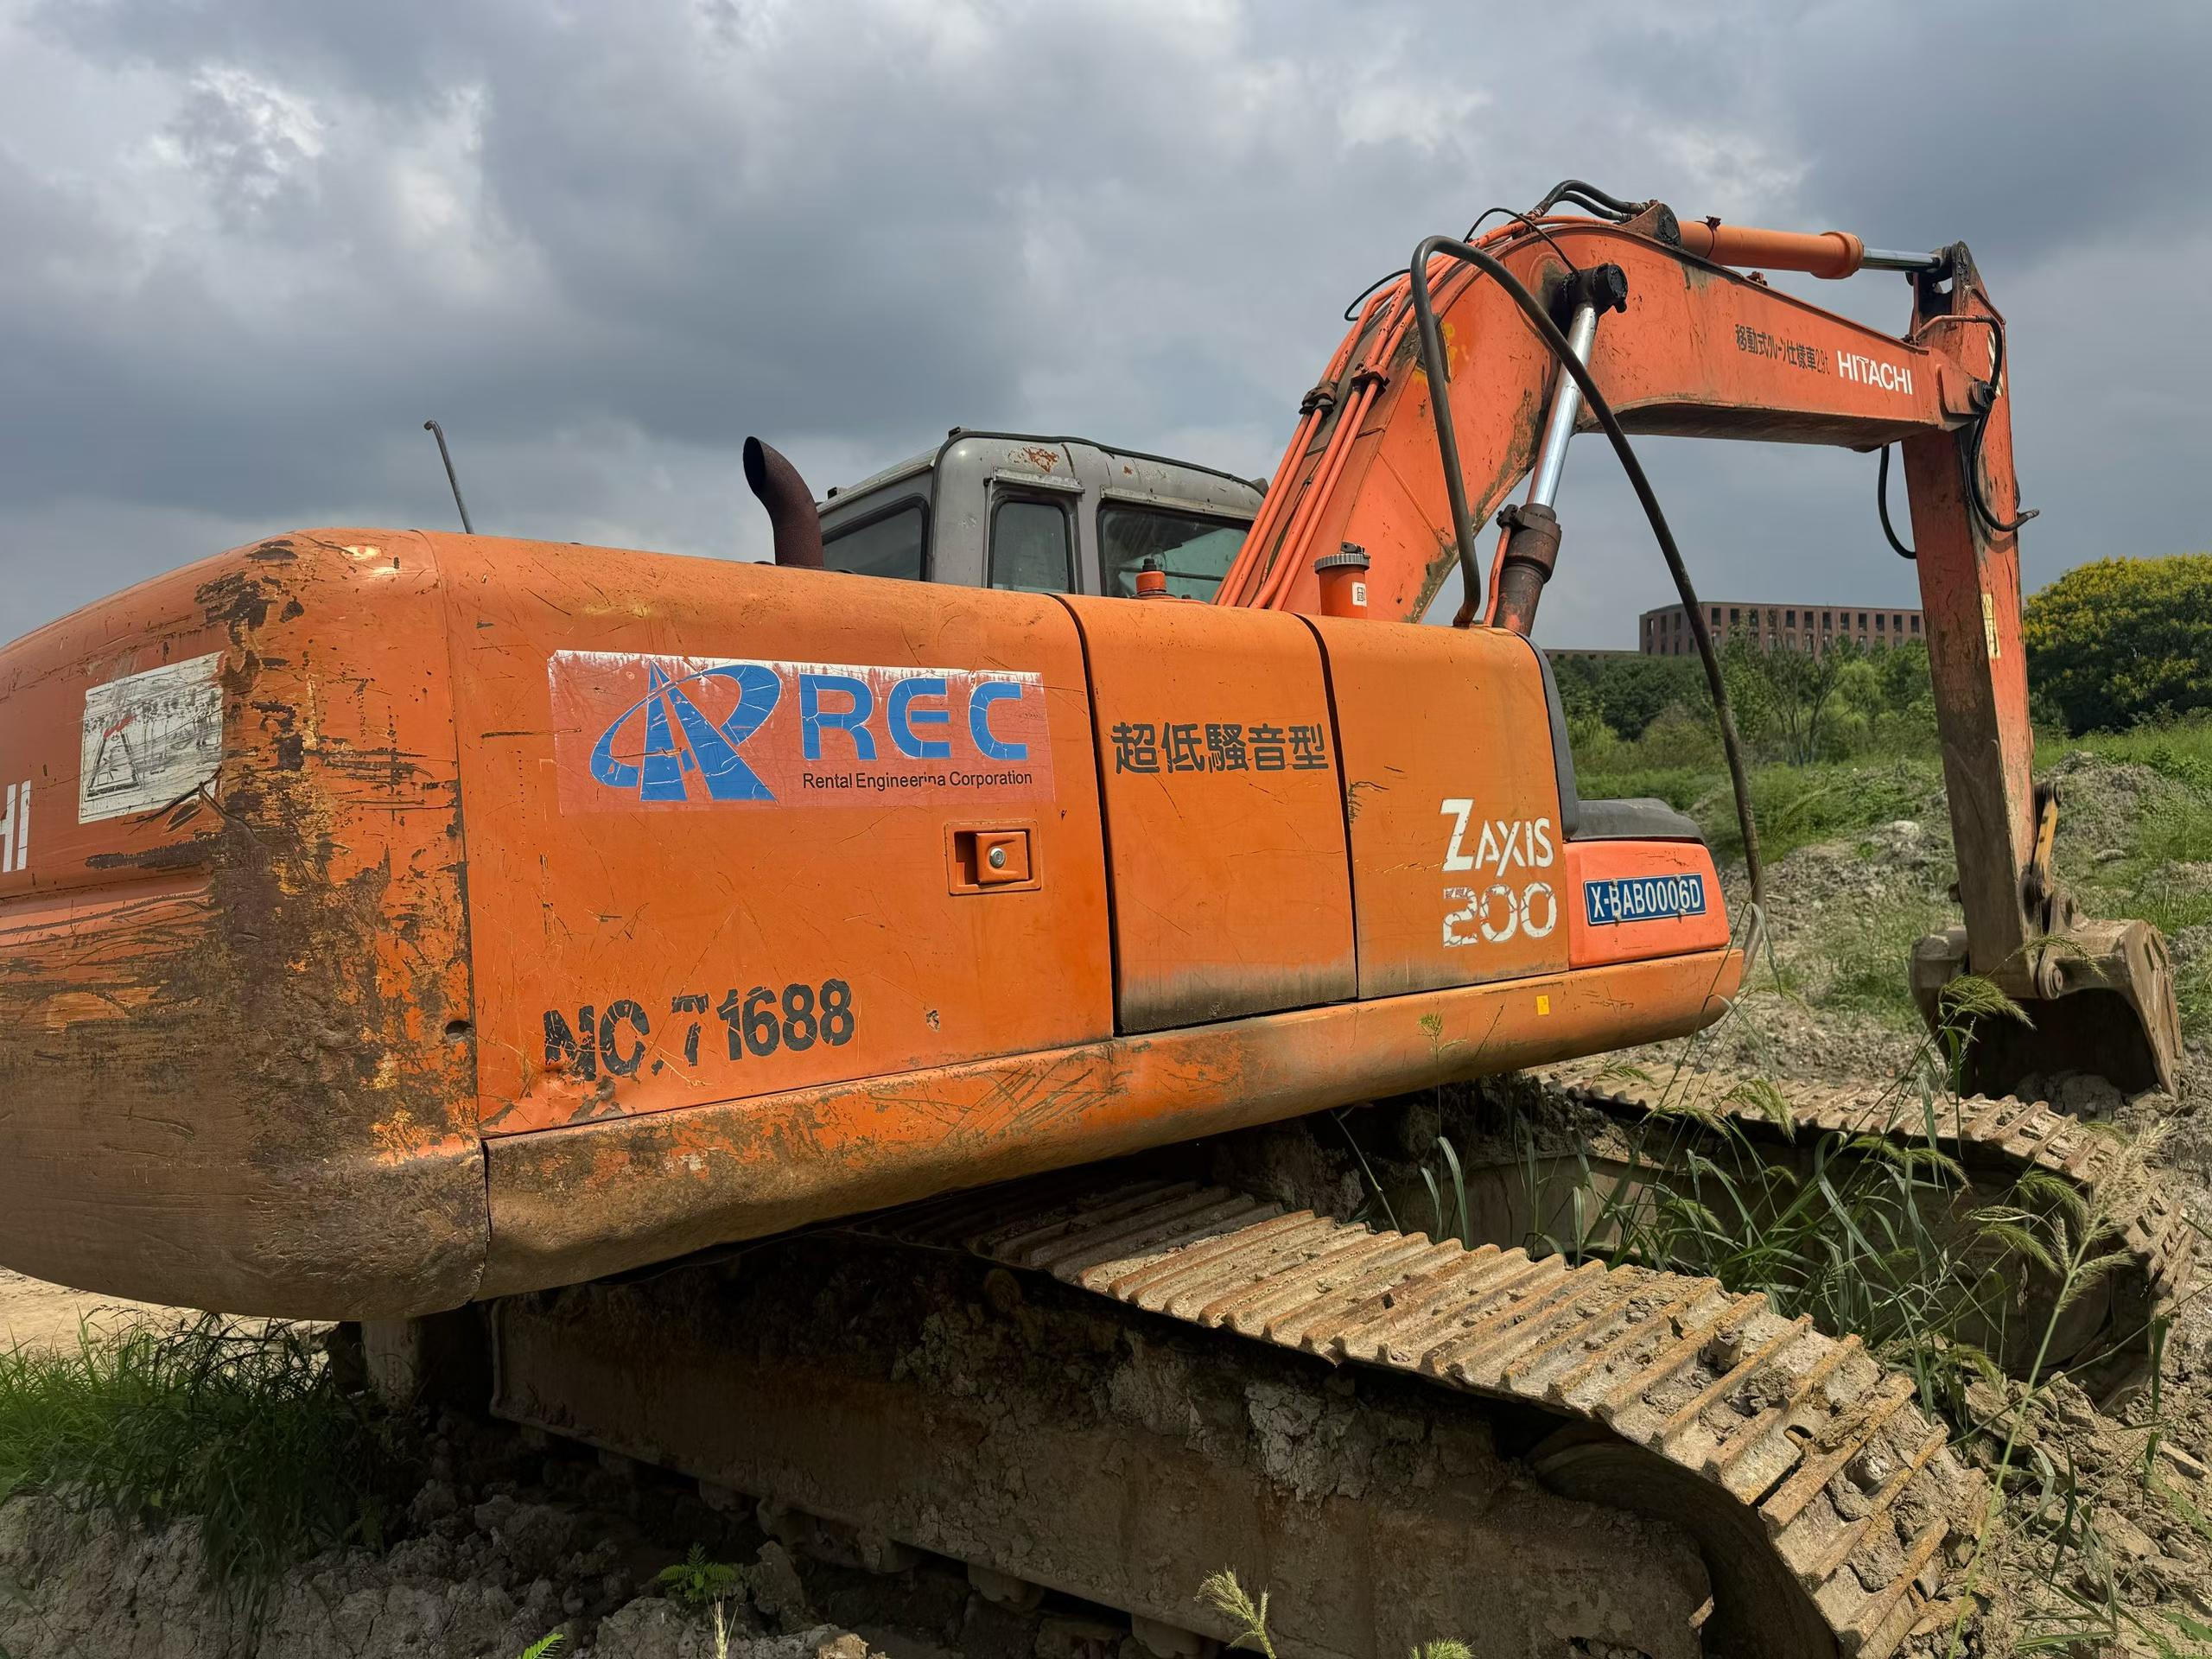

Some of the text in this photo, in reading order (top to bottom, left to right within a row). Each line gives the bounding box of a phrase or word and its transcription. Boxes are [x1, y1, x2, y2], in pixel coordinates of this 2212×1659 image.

[1837, 350, 1913, 395] HITACHI
[798, 672, 1028, 761] REC
[1111, 721, 1329, 774] 超低騒音型
[803, 772, 852, 788] Rental
[950, 770, 1033, 788] Corporation
[1440, 798, 1554, 877] ZAXIS
[1443, 881, 1557, 948] 200
[1591, 879, 1700, 918] X-BAB0006D
